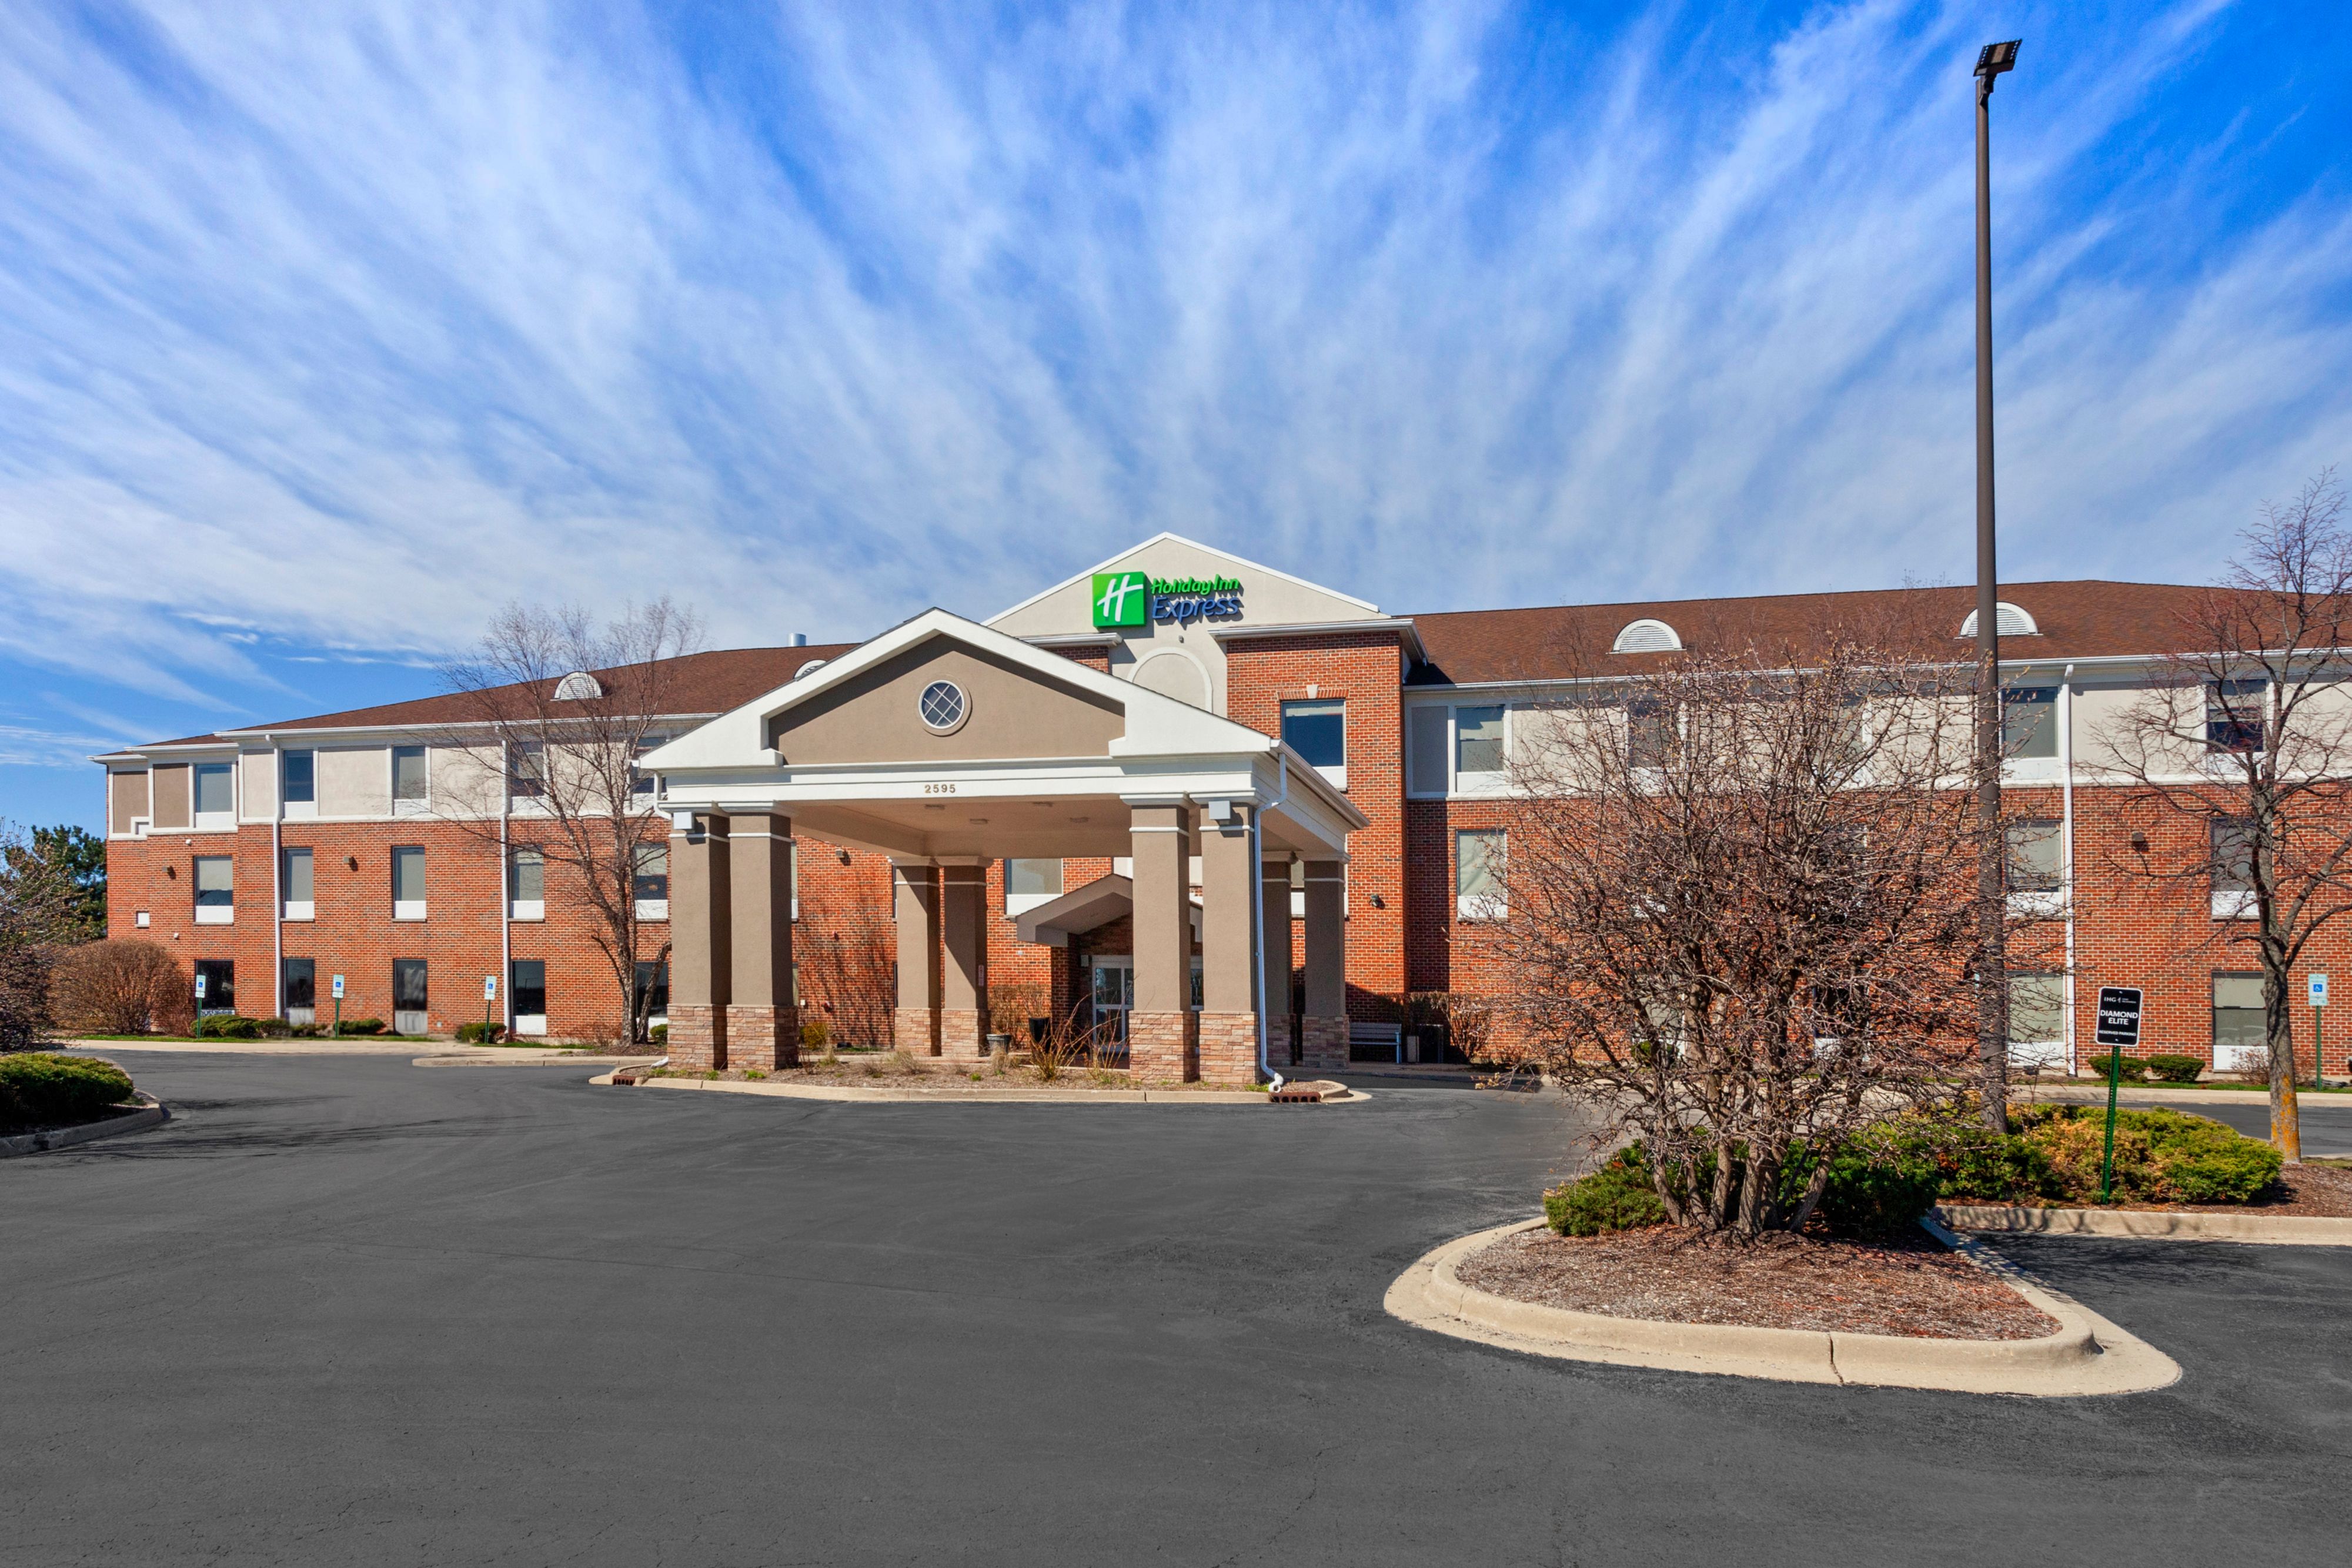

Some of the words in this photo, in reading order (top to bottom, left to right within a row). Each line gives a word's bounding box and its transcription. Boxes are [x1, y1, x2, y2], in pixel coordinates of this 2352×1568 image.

[1151, 576, 1212, 595] Holiday
[1213, 574, 1239, 591] Inn
[1152, 596, 1239, 623] Express
[924, 784, 956, 793] 2595
[2100, 1009, 2139, 1019] DIAMOND
[2108, 1017, 2129, 1025] ELITE
